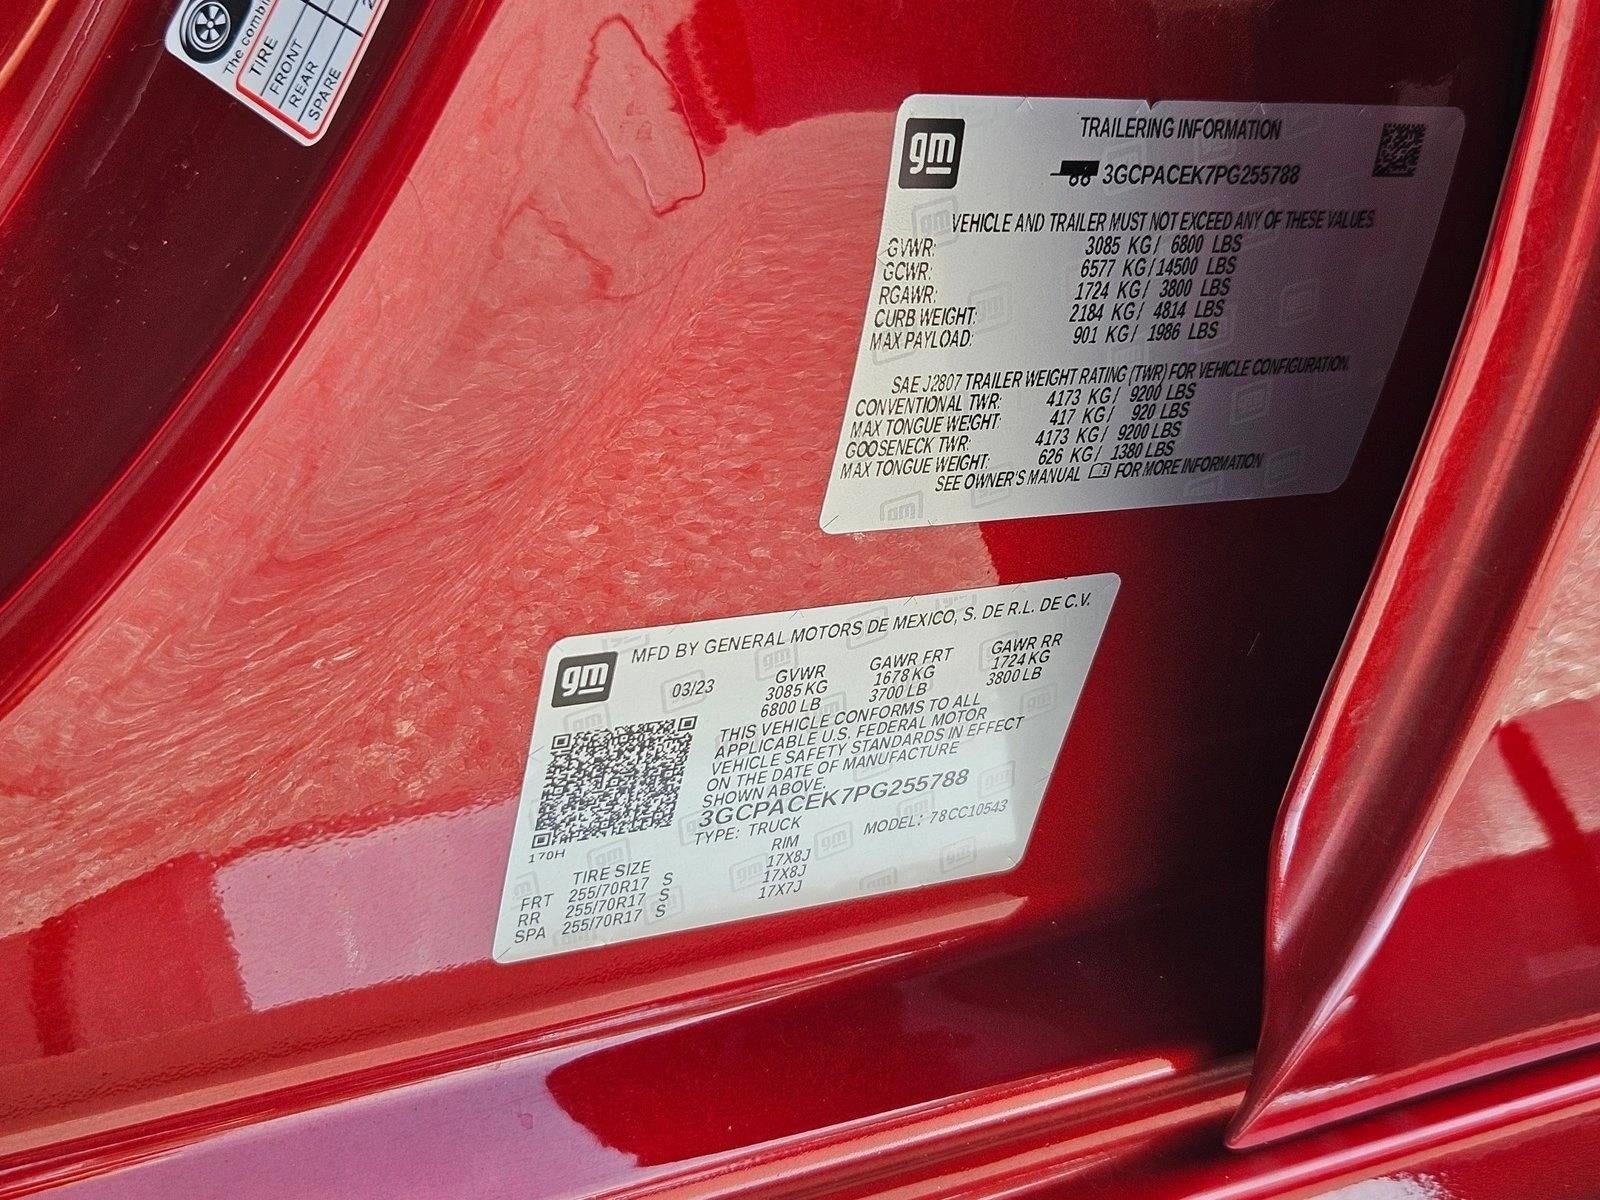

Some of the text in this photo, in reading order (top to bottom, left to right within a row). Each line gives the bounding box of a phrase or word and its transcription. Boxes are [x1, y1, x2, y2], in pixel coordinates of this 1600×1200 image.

[223, 0, 271, 75] The combi
[249, 36, 278, 79] TIRE
[269, 39, 303, 95] FRONT
[289, 60, 319, 108] REAR
[309, 67, 342, 121] SPARE
[1081, 116, 1282, 140] TRAILERING INFORMATION
[909, 132, 956, 175] gm
[1102, 164, 1301, 185] 3GCPACEK7PG255788
[952, 212, 1013, 233] VEHICLE
[1014, 213, 1046, 233] AND
[1050, 212, 1107, 232] TRAILER
[1109, 212, 1148, 232] MUST
[1150, 211, 1179, 231] NOT
[1180, 211, 1233, 231] EXCEED
[1234, 211, 1261, 230] ANY
[1264, 210, 1282, 230] OF
[1285, 210, 1327, 229] THESE
[1327, 210, 1376, 229] VALUES
[887, 237, 936, 257] GVWR:
[1085, 236, 1121, 255] 3085
[1170, 234, 1204, 254] 6800
[1212, 234, 1243, 253] LBS
[883, 262, 933, 281] GCWR:
[1080, 259, 1116, 278] 6577
[1206, 256, 1237, 275] LBS
[879, 285, 938, 305] RGAWR:
[1074, 281, 1110, 300] 1724
[1159, 278, 1193, 298] 3800
[1200, 278, 1231, 296] LBS
[874, 309, 916, 328] CURB
[920, 306, 978, 326] WEIGHT:
[1069, 303, 1104, 322] 2184
[1153, 301, 1187, 319] 4814
[1194, 300, 1225, 318] LBS
[869, 331, 902, 351] MAX
[904, 329, 974, 349] PAYLOAD:
[1073, 326, 1098, 344] 901
[1147, 322, 1181, 341] 1986
[1188, 321, 1219, 340] LBS
[891, 376, 921, 394] SAE
[922, 374, 963, 392] J2807
[965, 371, 1023, 390] TRAILER
[1025, 368, 1078, 387] WEIGHT
[1079, 365, 1128, 385] RATING
[1129, 363, 1167, 387] (TWR)
[1168, 362, 1197, 380] FOR
[1199, 359, 1251, 379] VEHICLE
[855, 394, 962, 417] CONVENTIONAL
[969, 393, 1002, 411] TWR:
[1046, 389, 1082, 407] 4173
[1129, 384, 1162, 402] 9200
[1166, 383, 1197, 401] LBS
[850, 419, 883, 438] MAX
[886, 416, 944, 436] TONGUE
[947, 413, 1001, 432] WEIGHT:
[1050, 409, 1076, 426] 417
[1131, 403, 1157, 421] 920
[1160, 402, 1190, 419] LBS
[845, 436, 935, 459] GOOSENECK
[939, 435, 971, 453] TWR:
[1035, 428, 1070, 446] 4173
[1117, 423, 1150, 441] 9200
[1151, 421, 1182, 439] LBS
[839, 460, 873, 480] MAX
[875, 457, 934, 477] TONGUE
[935, 453, 990, 473] WEIGHT:
[1038, 447, 1063, 466] 626
[1110, 442, 1143, 461] 1380
[1145, 440, 1175, 458] LBS
[935, 453, 1264, 492] SEE OWNER'S MANUAL FOR MORE INFORMATION
[631, 593, 1091, 664] MFD BY GENERAL MOTORS DE MEXICO, S. DE R.L. DE C.V.
[991, 633, 1063, 655] GAWR RR
[775, 664, 826, 684] GVWR
[869, 647, 954, 671] GAWR FRT
[561, 662, 609, 697] gm
[672, 678, 715, 698] 03/23
[714, 707, 988, 760] APPLICABLE U.S. FEDERAL MOTOR
[720, 692, 981, 743] THIS VEHICLE CONFORMS TO ALL
[712, 716, 1025, 776] VEHICLE SAFETY STANDARDS IN EFFECT
[706, 740, 960, 792] ON THE DATE OF MANUFACTURE
[699, 768, 970, 828] 3GCPACEK7PG255788
[702, 777, 826, 809] SHOWN ABOVE.
[695, 826, 740, 845] TYPE:
[750, 816, 802, 836] TRUCK
[863, 814, 923, 836] MODEL:
[929, 799, 1009, 824] 78CC10543
[528, 849, 566, 864] 170H
[771, 834, 800, 851] RIM
[520, 849, 811, 911] FRT 255/70R17 S 17X8J
[573, 859, 651, 885] TIRE SIZE
[514, 880, 803, 944] SPA 255/70R17 S 17X7J
[517, 912, 541, 927] RR
[565, 893, 646, 919] 255/70R17
[659, 888, 670, 901] S
[762, 864, 807, 884] 17X8J
